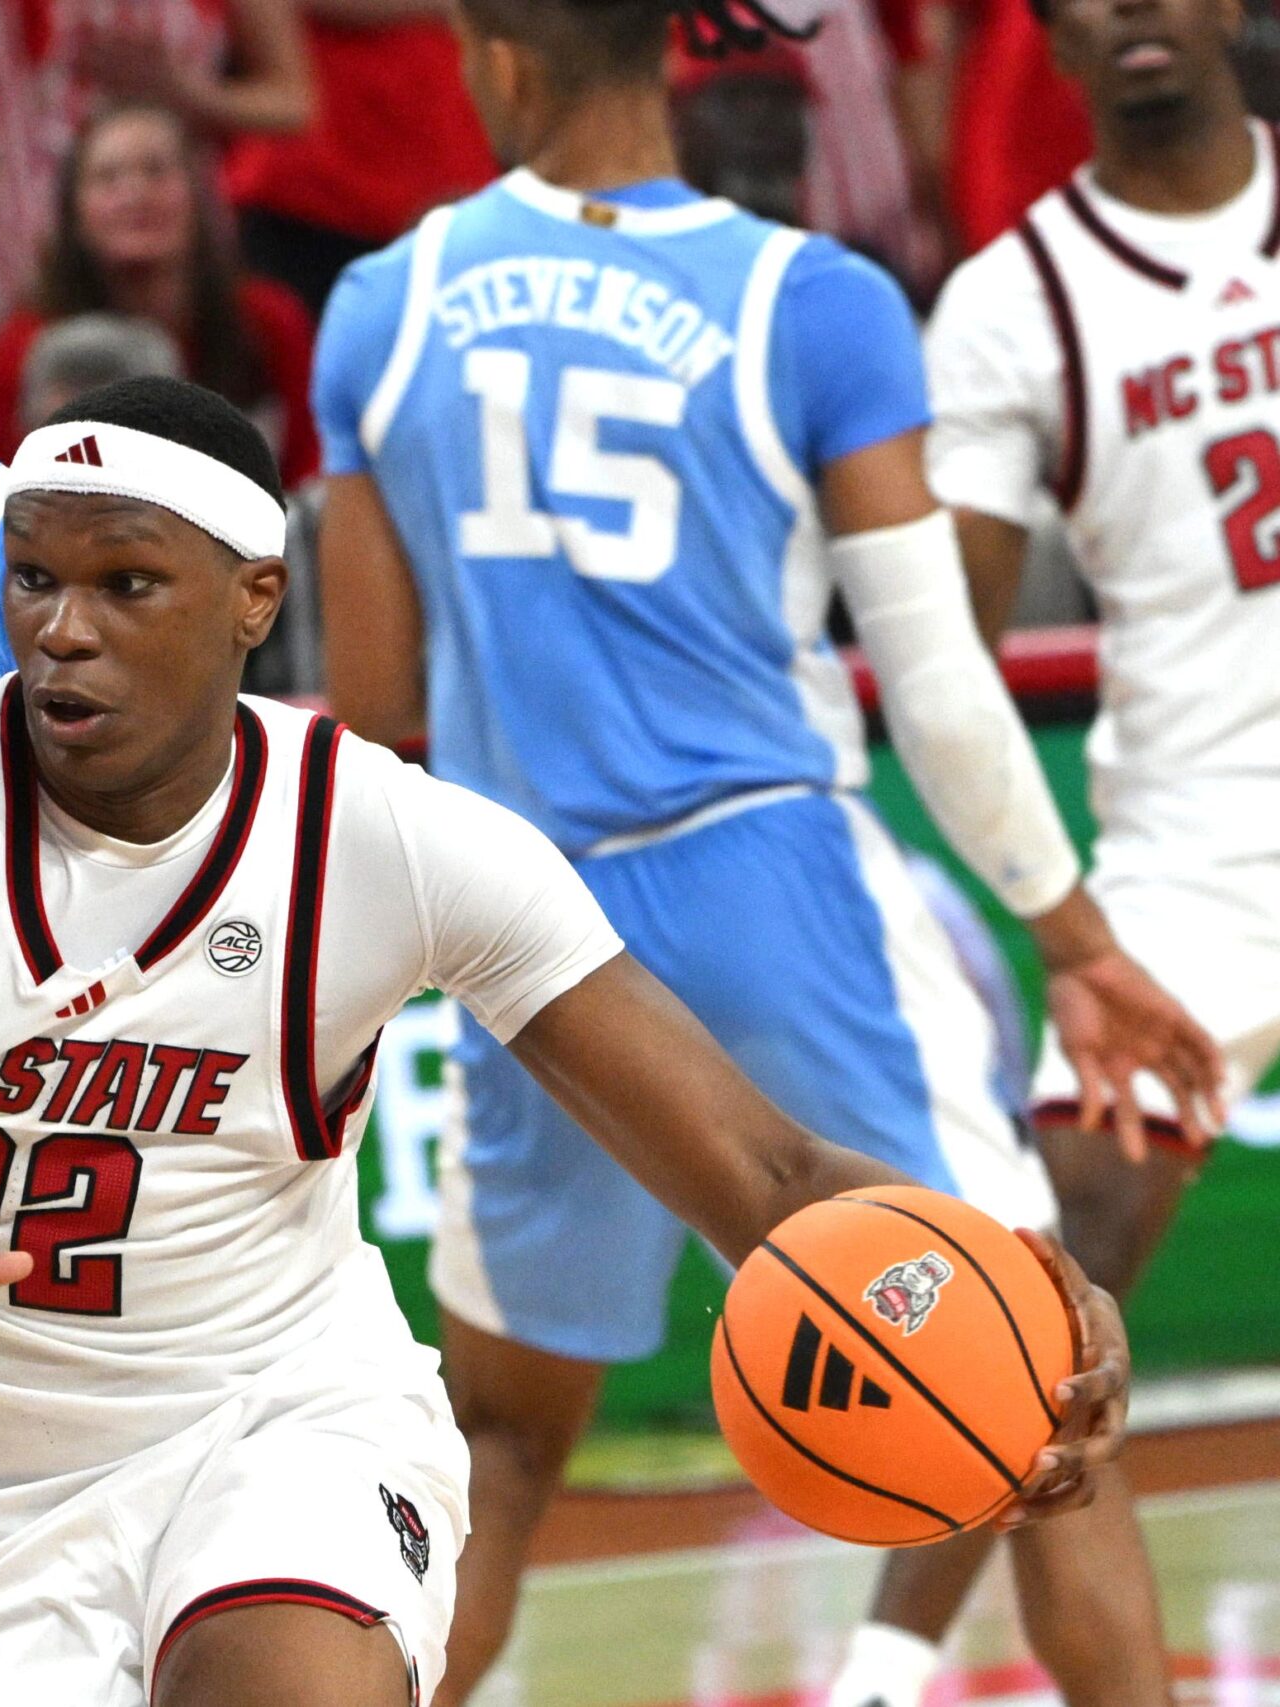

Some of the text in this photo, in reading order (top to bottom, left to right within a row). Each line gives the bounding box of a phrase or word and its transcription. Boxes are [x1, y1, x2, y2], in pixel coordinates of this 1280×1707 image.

[436, 256, 733, 387] STEVENSON
[1119, 355, 1199, 438] NC
[459, 347, 687, 583] 15
[214, 936, 260, 951] ACC
